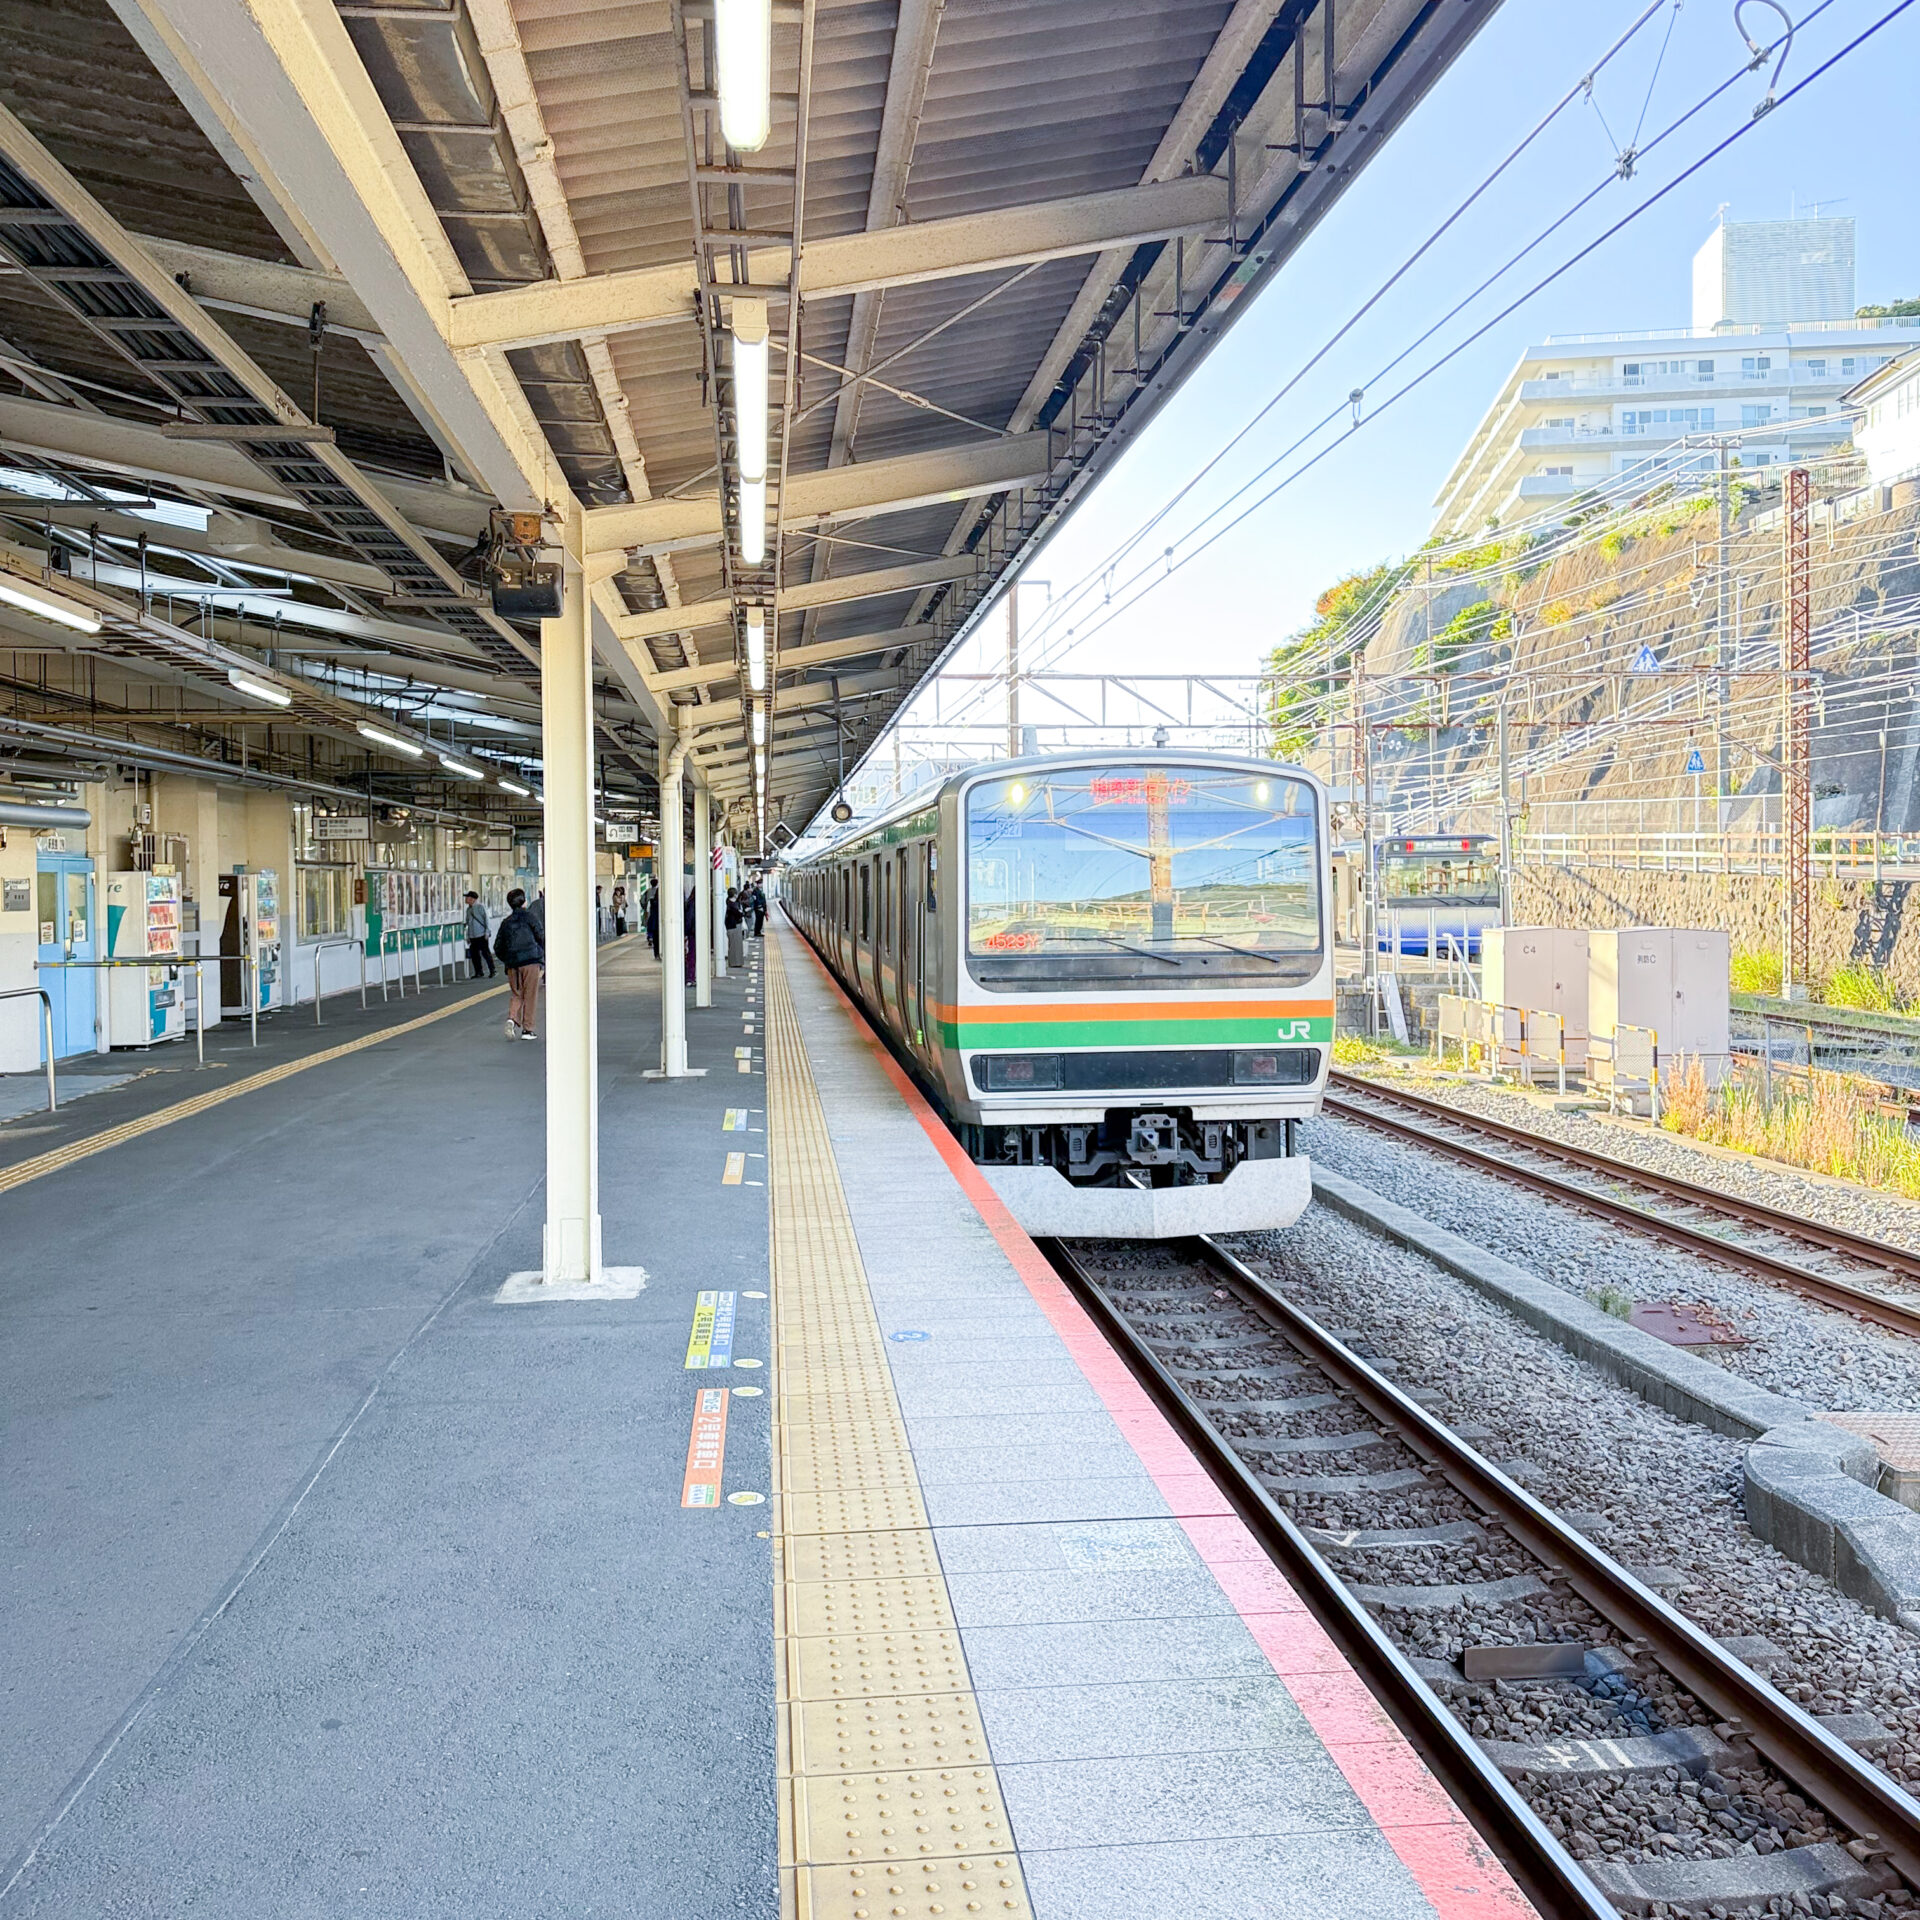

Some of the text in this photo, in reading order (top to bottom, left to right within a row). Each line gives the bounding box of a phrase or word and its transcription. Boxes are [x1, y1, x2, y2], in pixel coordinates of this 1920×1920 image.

[986, 933, 1040, 949] 4529Y
[1278, 1021, 1311, 1040] JR
[692, 1416, 723, 1469] 2号車乗車口
